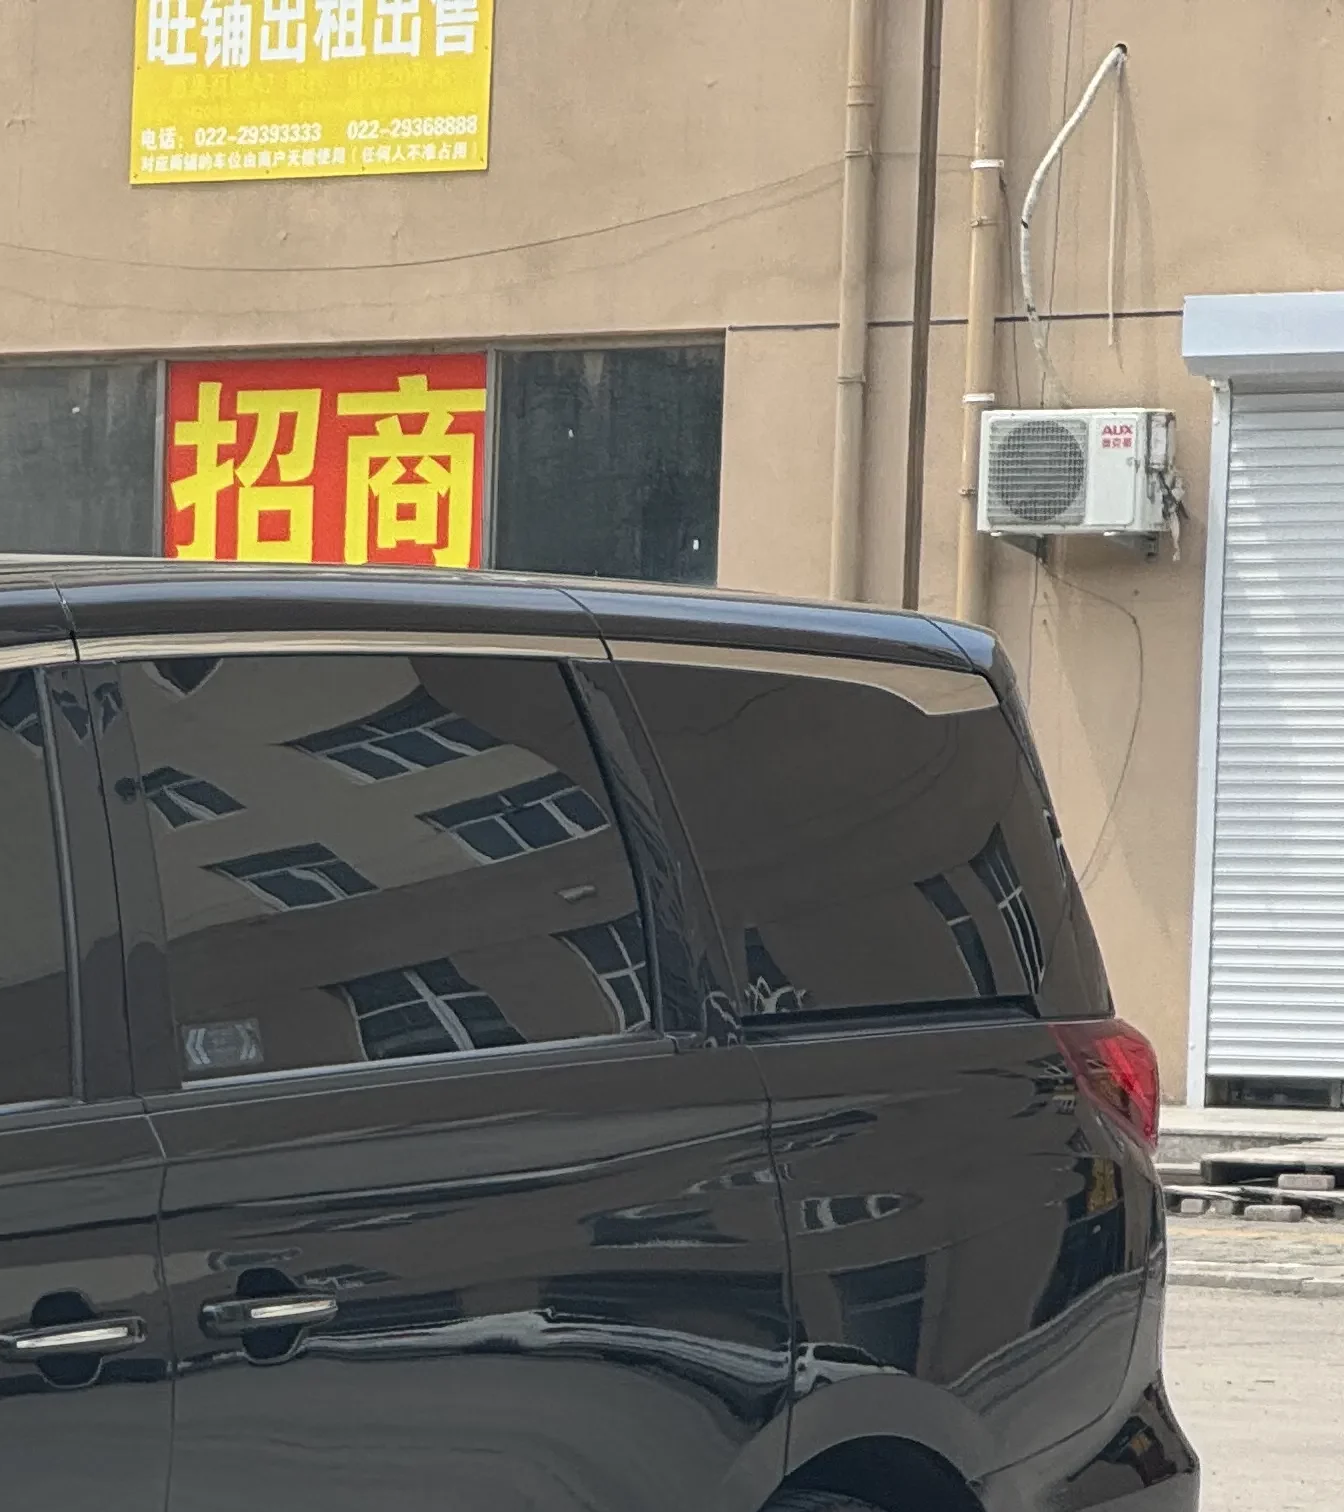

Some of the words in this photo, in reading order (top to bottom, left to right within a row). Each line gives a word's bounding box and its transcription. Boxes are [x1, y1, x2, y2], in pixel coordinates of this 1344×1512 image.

[147, 0, 480, 67] 旺铺出租出售
[195, 122, 322, 147] 022-29393333
[347, 114, 478, 140] 022-29368888
[1101, 424, 1133, 435] AUX
[171, 374, 486, 567] 招商
